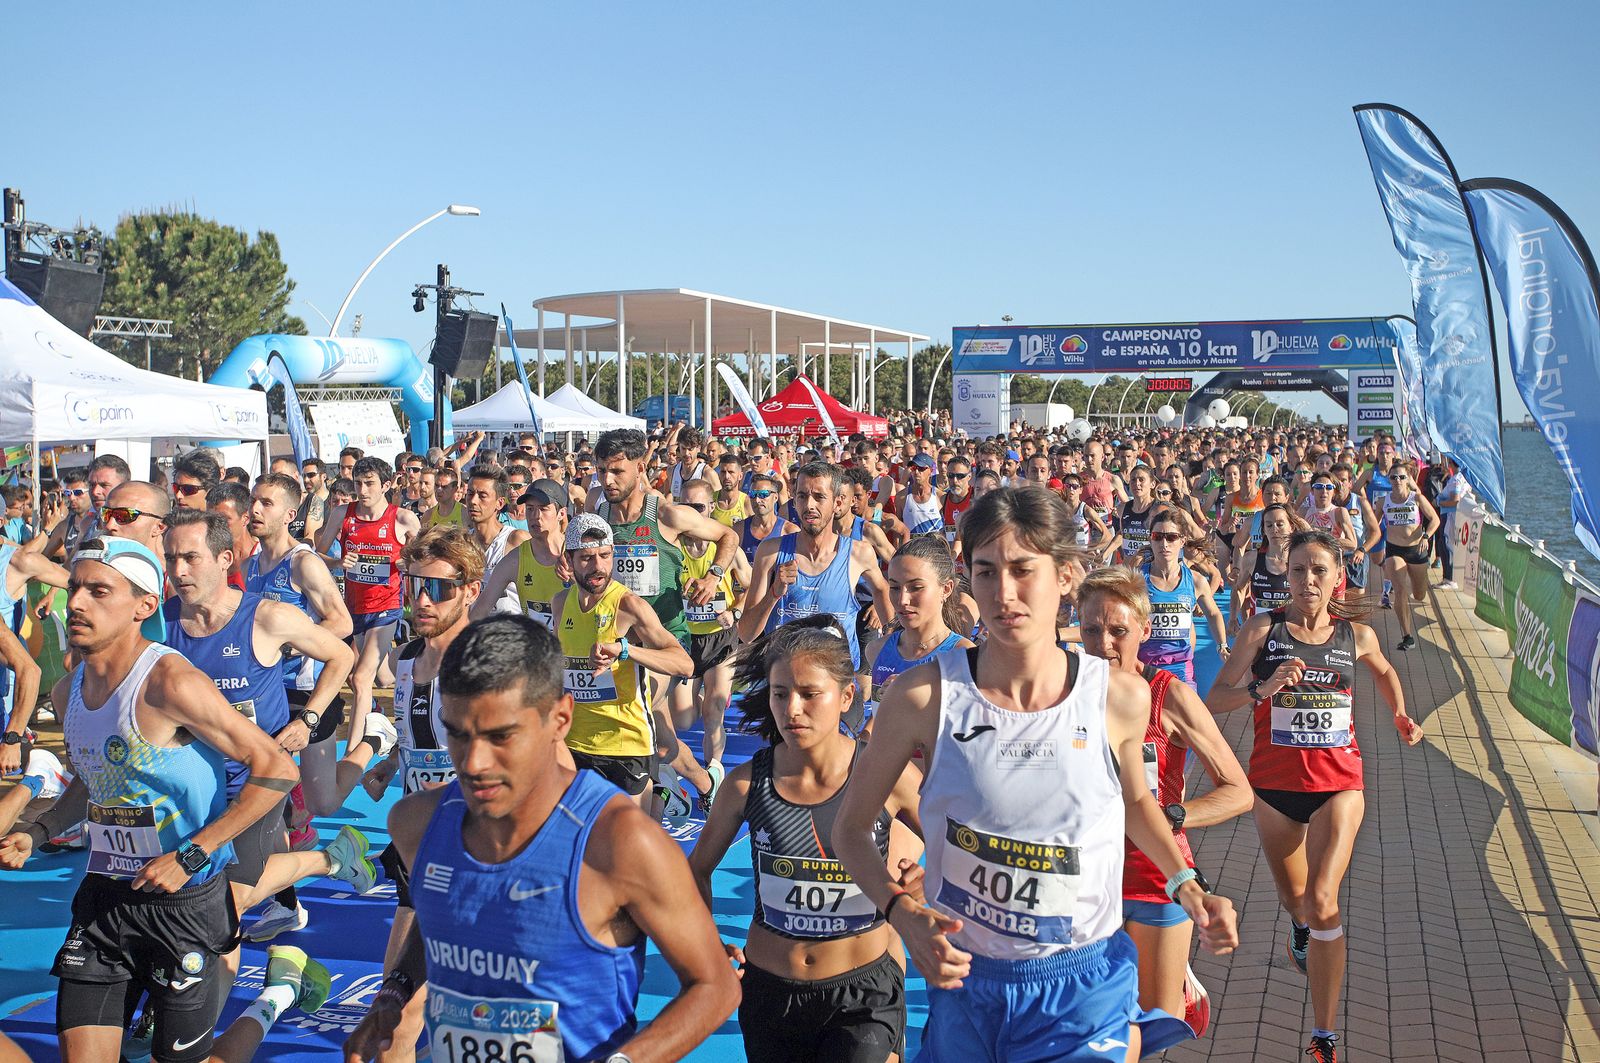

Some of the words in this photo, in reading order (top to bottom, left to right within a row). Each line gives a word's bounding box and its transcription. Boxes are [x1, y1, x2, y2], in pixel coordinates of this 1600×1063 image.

[1102, 329, 1202, 341] CAMPEONATO
[1101, 348, 1117, 356] de
[1120, 343, 1170, 356] ESPAÑA
[1178, 342, 1201, 357] 10
[1207, 340, 1238, 356] km
[1251, 330, 1277, 362] 10
[1277, 336, 1319, 348] HUELVA
[1356, 337, 1394, 348] WiHu
[1019, 335, 1042, 365] 10
[1063, 355, 1084, 363] WiHu
[719, 426, 801, 435] SPORTANIACS
[346, 541, 392, 551] mediolanum
[360, 564, 375, 575] 66
[617, 559, 644, 573] 899
[789, 603, 819, 611] CLUB
[1152, 615, 1179, 628] 499
[1268, 640, 1294, 651] Bilbao
[568, 672, 597, 688] 182
[1304, 670, 1333, 684] BM
[1290, 711, 1333, 730] 498
[1000, 749, 1054, 759] VALENCIA
[102, 808, 143, 816] RUNNING
[115, 818, 136, 826] LOOP
[103, 829, 137, 855] 101
[989, 837, 1066, 858] RUNNING
[802, 860, 844, 871] RUNNI
[1006, 857, 1052, 871] LOOP
[817, 873, 852, 882] LOOP
[969, 864, 1040, 910] 404
[784, 885, 846, 913] 407
[426, 937, 540, 984] URUGUAY
[444, 1001, 469, 1018] HUELVA
[501, 1009, 541, 1028] 2023
[443, 1031, 537, 1063] 1886
